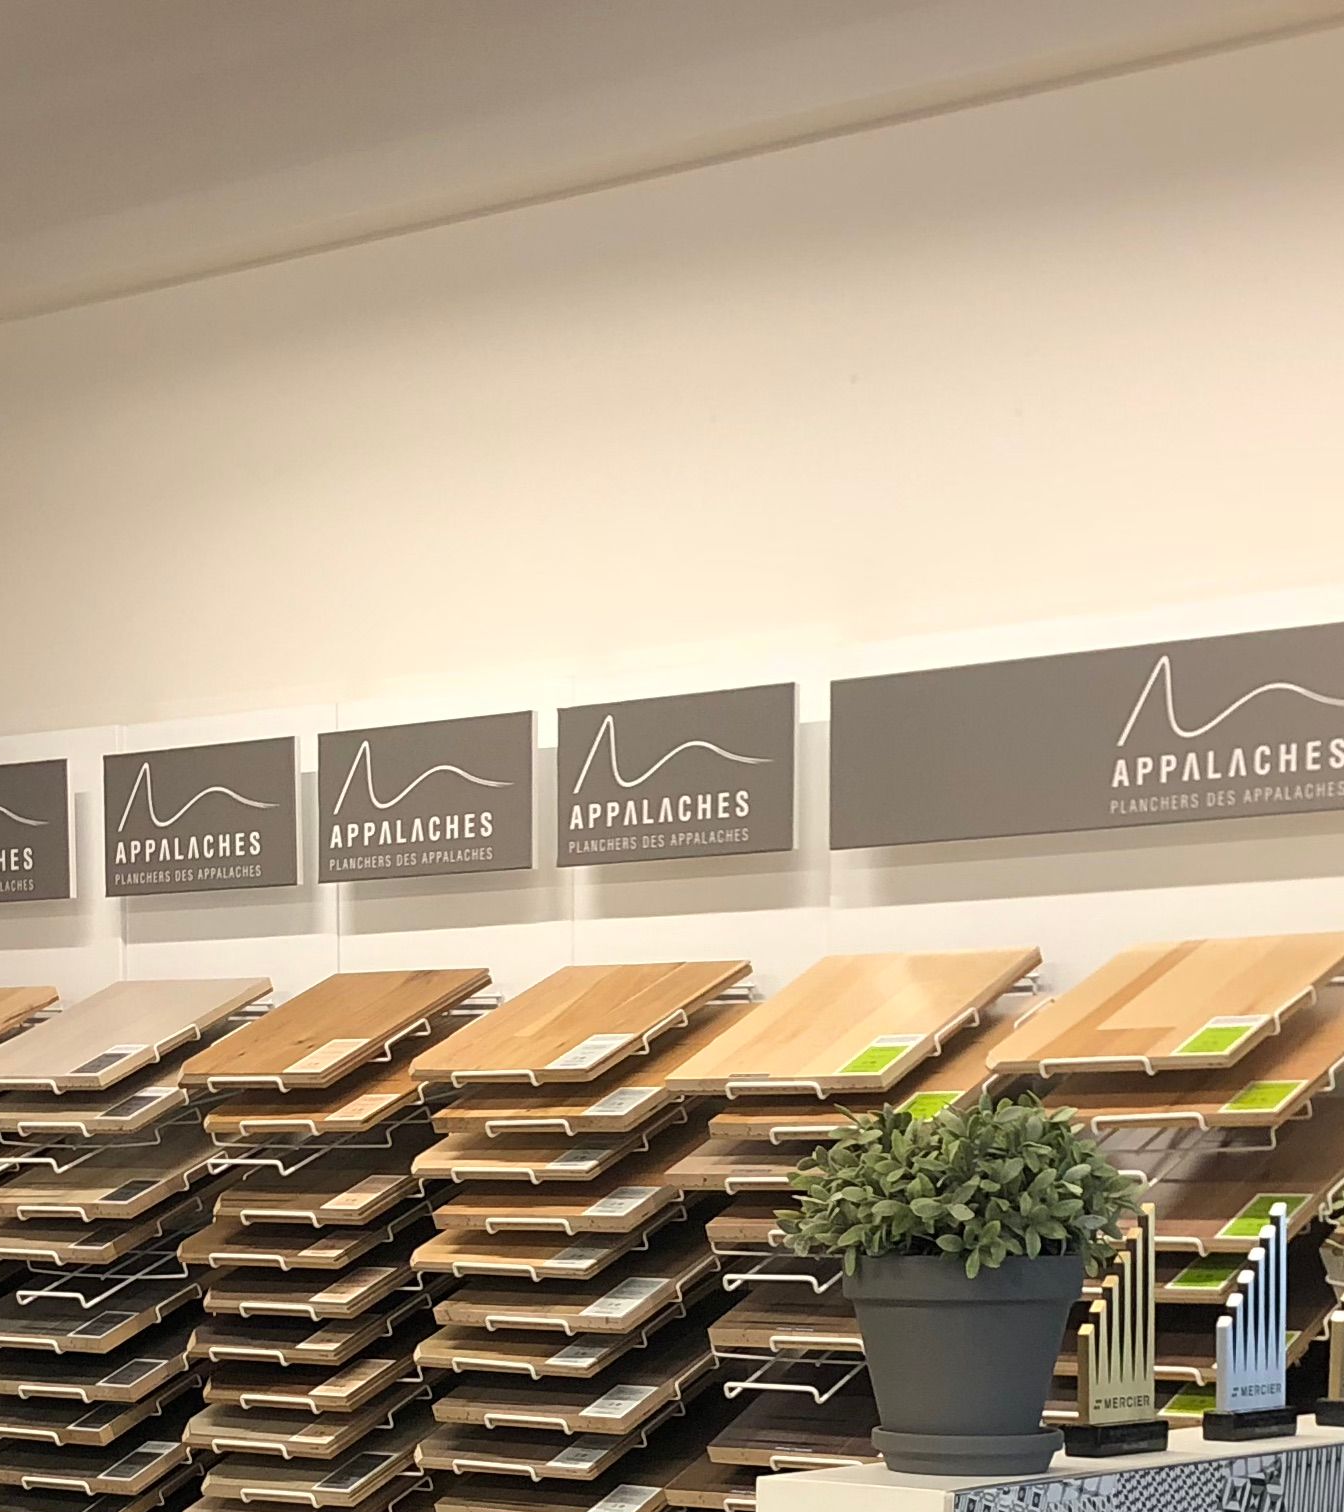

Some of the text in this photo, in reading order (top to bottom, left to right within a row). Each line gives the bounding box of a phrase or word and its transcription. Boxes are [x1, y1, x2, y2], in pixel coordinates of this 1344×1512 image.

[570, 789, 750, 830] APPALACHES
[1110, 793, 1200, 814] PLANCHERS
[1207, 790, 1236, 808] DES
[330, 811, 493, 849] APPALACHES
[569, 827, 750, 854] PLANCHERS DES APPALACHES
[115, 831, 261, 864] APPALACHES
[330, 846, 493, 871] PLANCHERS DES APPALACHES
[115, 865, 261, 886] PLANCHERS DES APPALACHES
[1103, 1395, 1150, 1409] MERCIER
[1241, 1383, 1282, 1397] MERCIER
